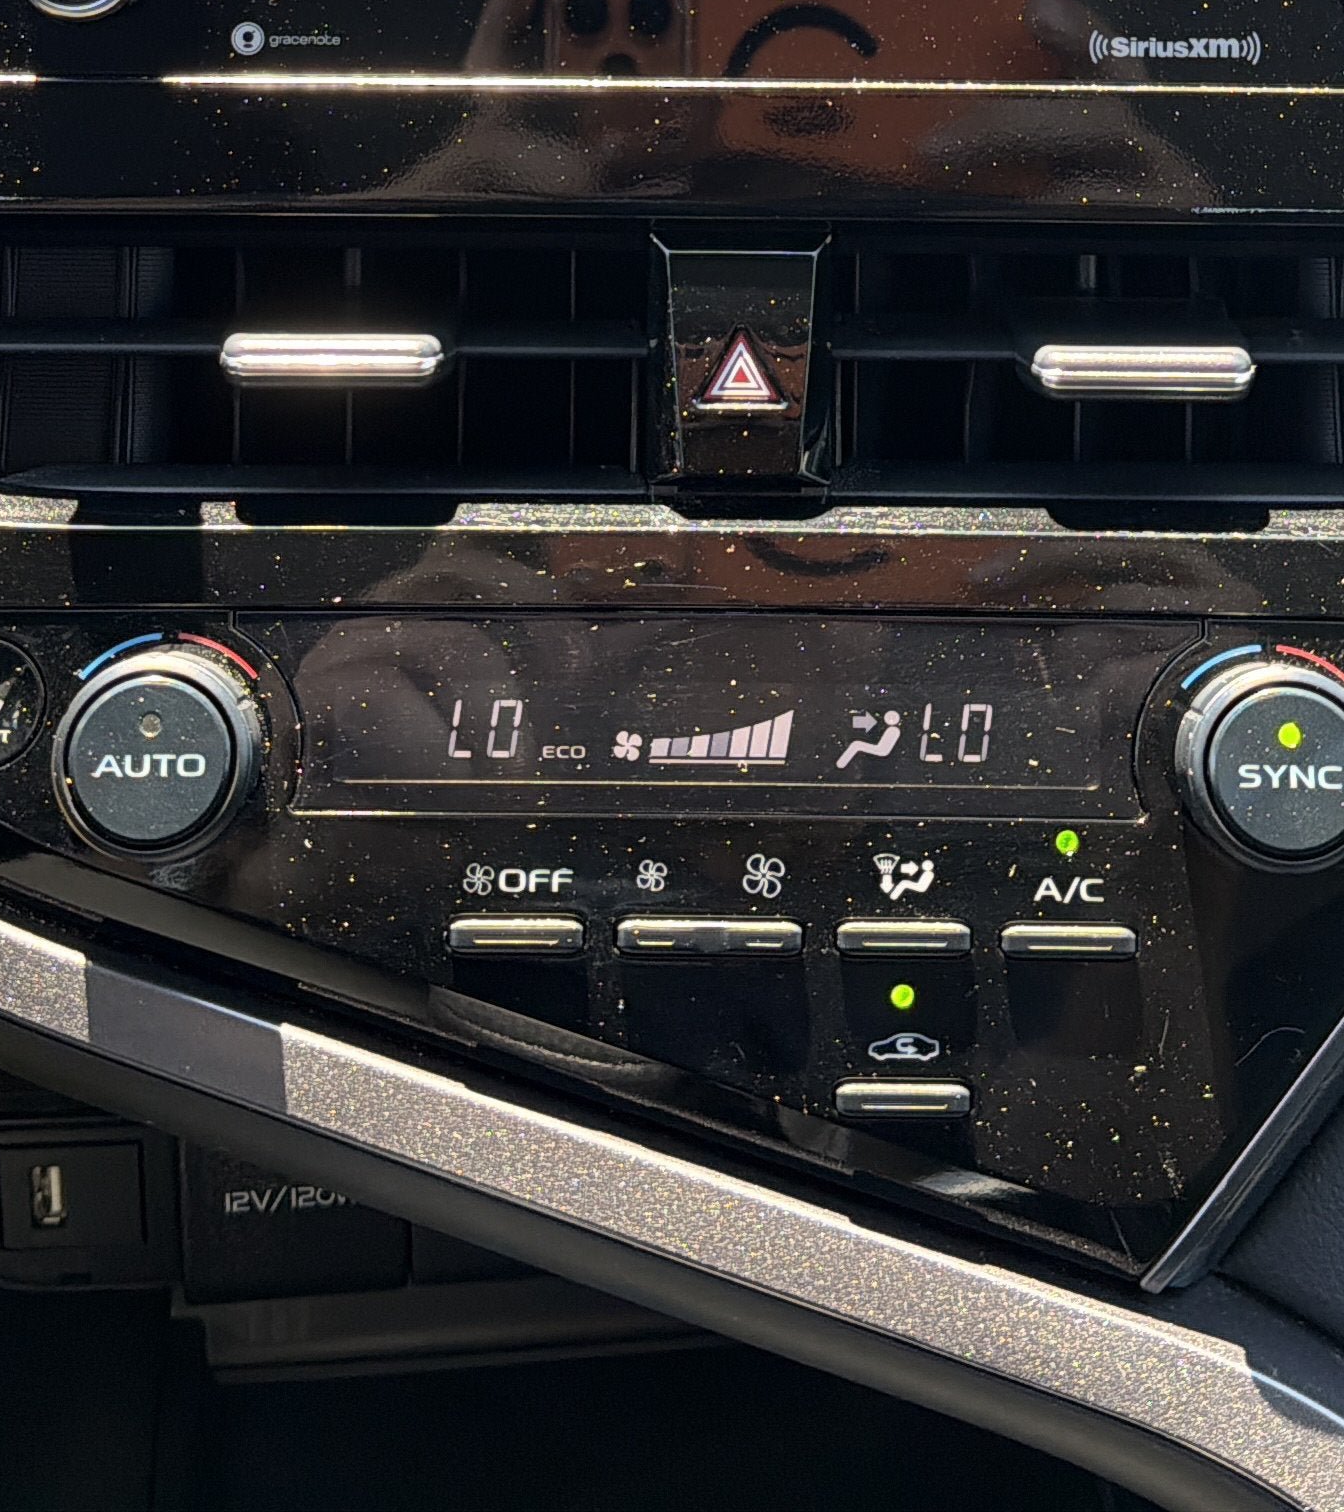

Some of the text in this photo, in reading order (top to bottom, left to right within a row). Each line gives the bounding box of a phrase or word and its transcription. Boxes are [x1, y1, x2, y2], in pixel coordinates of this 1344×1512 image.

[269, 34, 341, 48] gracenote
[542, 745, 586, 759] ECO
[91, 754, 206, 778] AUTO
[1238, 764, 1343, 790] SYNC
[498, 869, 574, 893] OFF
[1033, 877, 1105, 904] A/C
